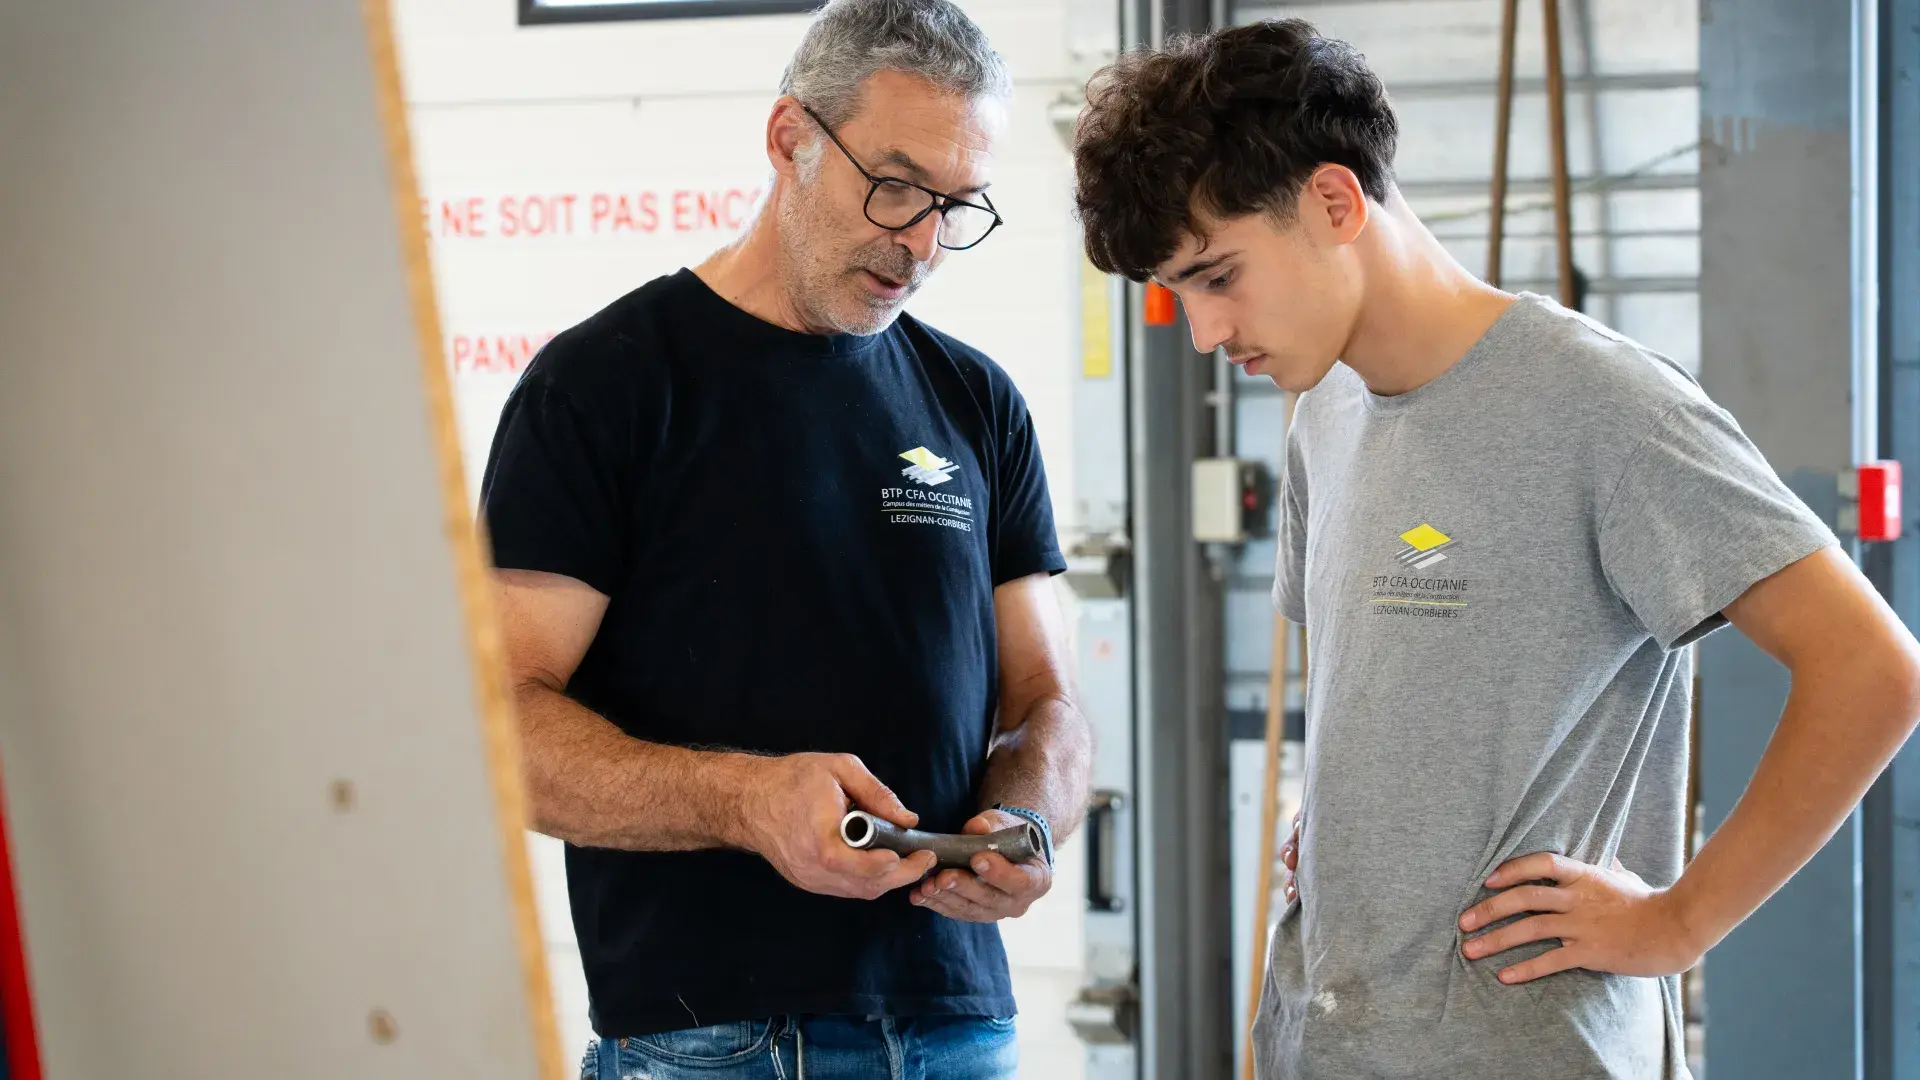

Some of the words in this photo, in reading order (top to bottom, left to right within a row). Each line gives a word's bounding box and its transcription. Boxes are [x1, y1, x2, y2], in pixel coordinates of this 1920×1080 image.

[441, 196, 487, 237] NE
[499, 194, 577, 237] SOIT
[590, 192, 660, 233] PAS
[453, 331, 557, 374] PANN
[881, 488, 903, 499] BTP
[905, 489, 926, 501] CFA
[928, 491, 972, 509] OCCITANIE
[882, 500, 905, 508] Campus
[890, 514, 971, 532] LEZIGNAN-CORBIERES
[1372, 576, 1388, 588] BTP
[1390, 576, 1408, 588] CFA
[1410, 577, 1468, 591] OCCITANIE
[1373, 605, 1458, 618] LEZIGNAN-CORBIERES
